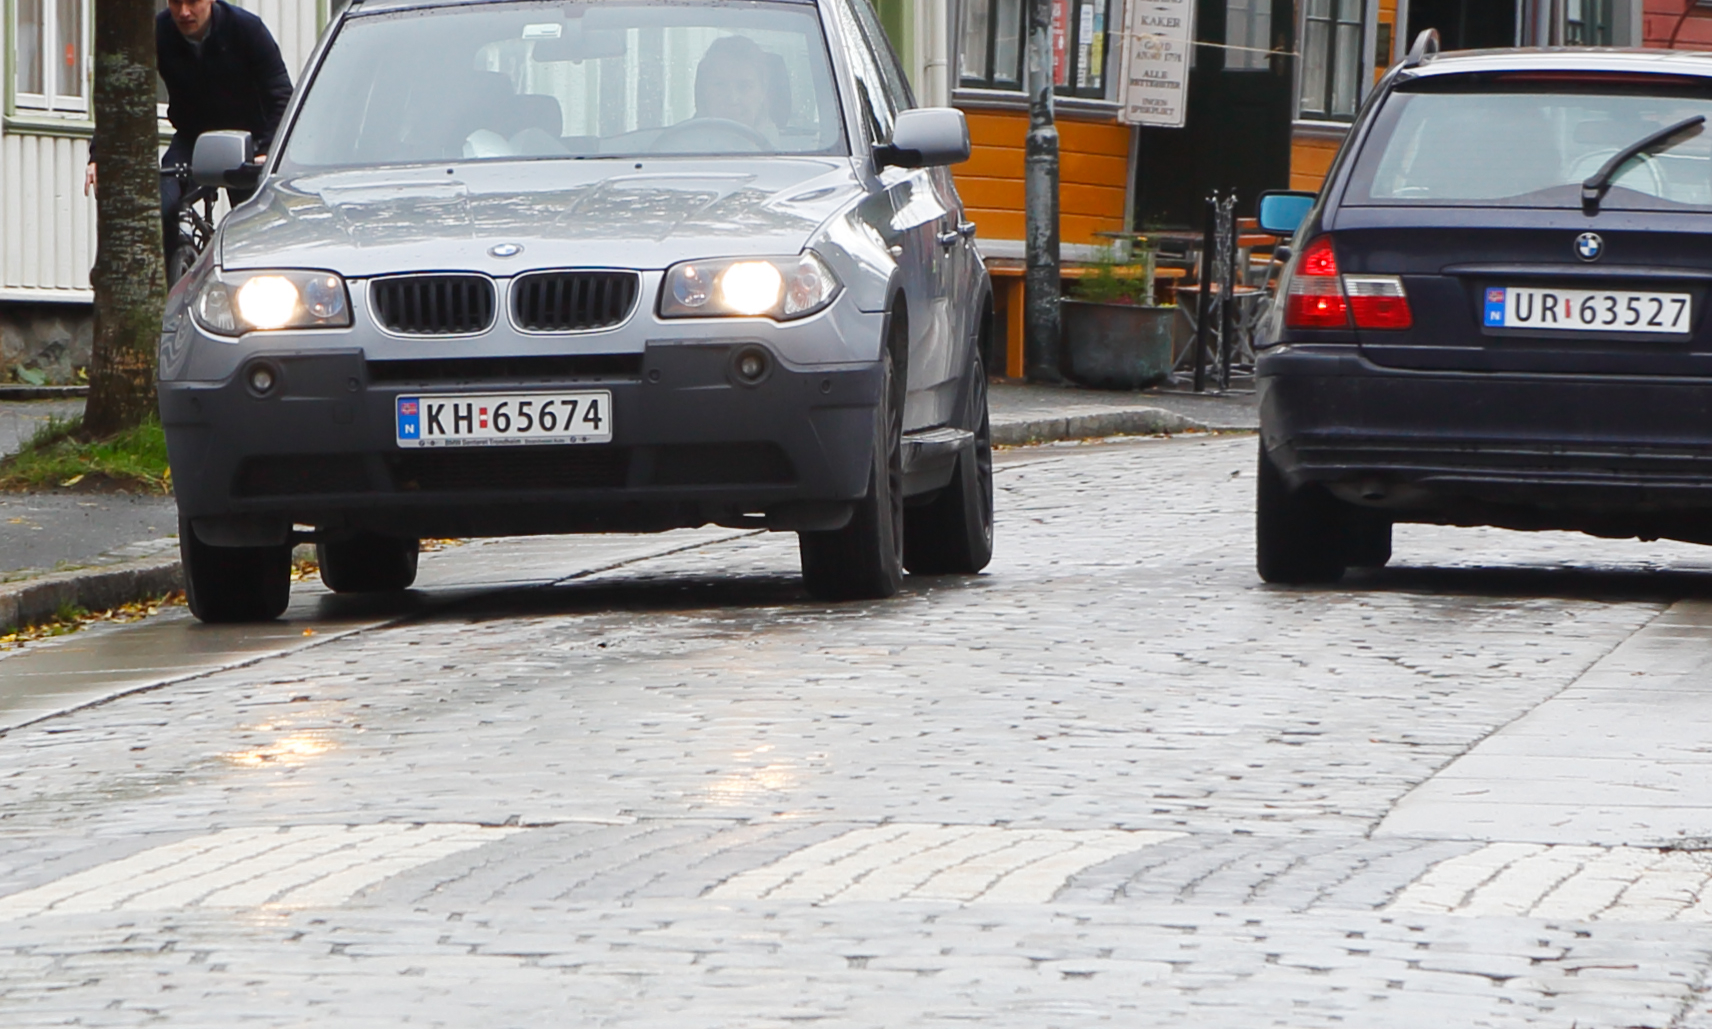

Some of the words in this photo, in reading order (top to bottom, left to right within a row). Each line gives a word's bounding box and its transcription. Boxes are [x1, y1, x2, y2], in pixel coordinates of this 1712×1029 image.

[1140, 15, 1181, 28] KAKER
[1490, 310, 1502, 321] N
[1514, 292, 1559, 323] UR
[1579, 295, 1687, 328] 63527
[426, 403, 473, 436] KH
[492, 399, 603, 434] 65674
[404, 424, 415, 435] N
